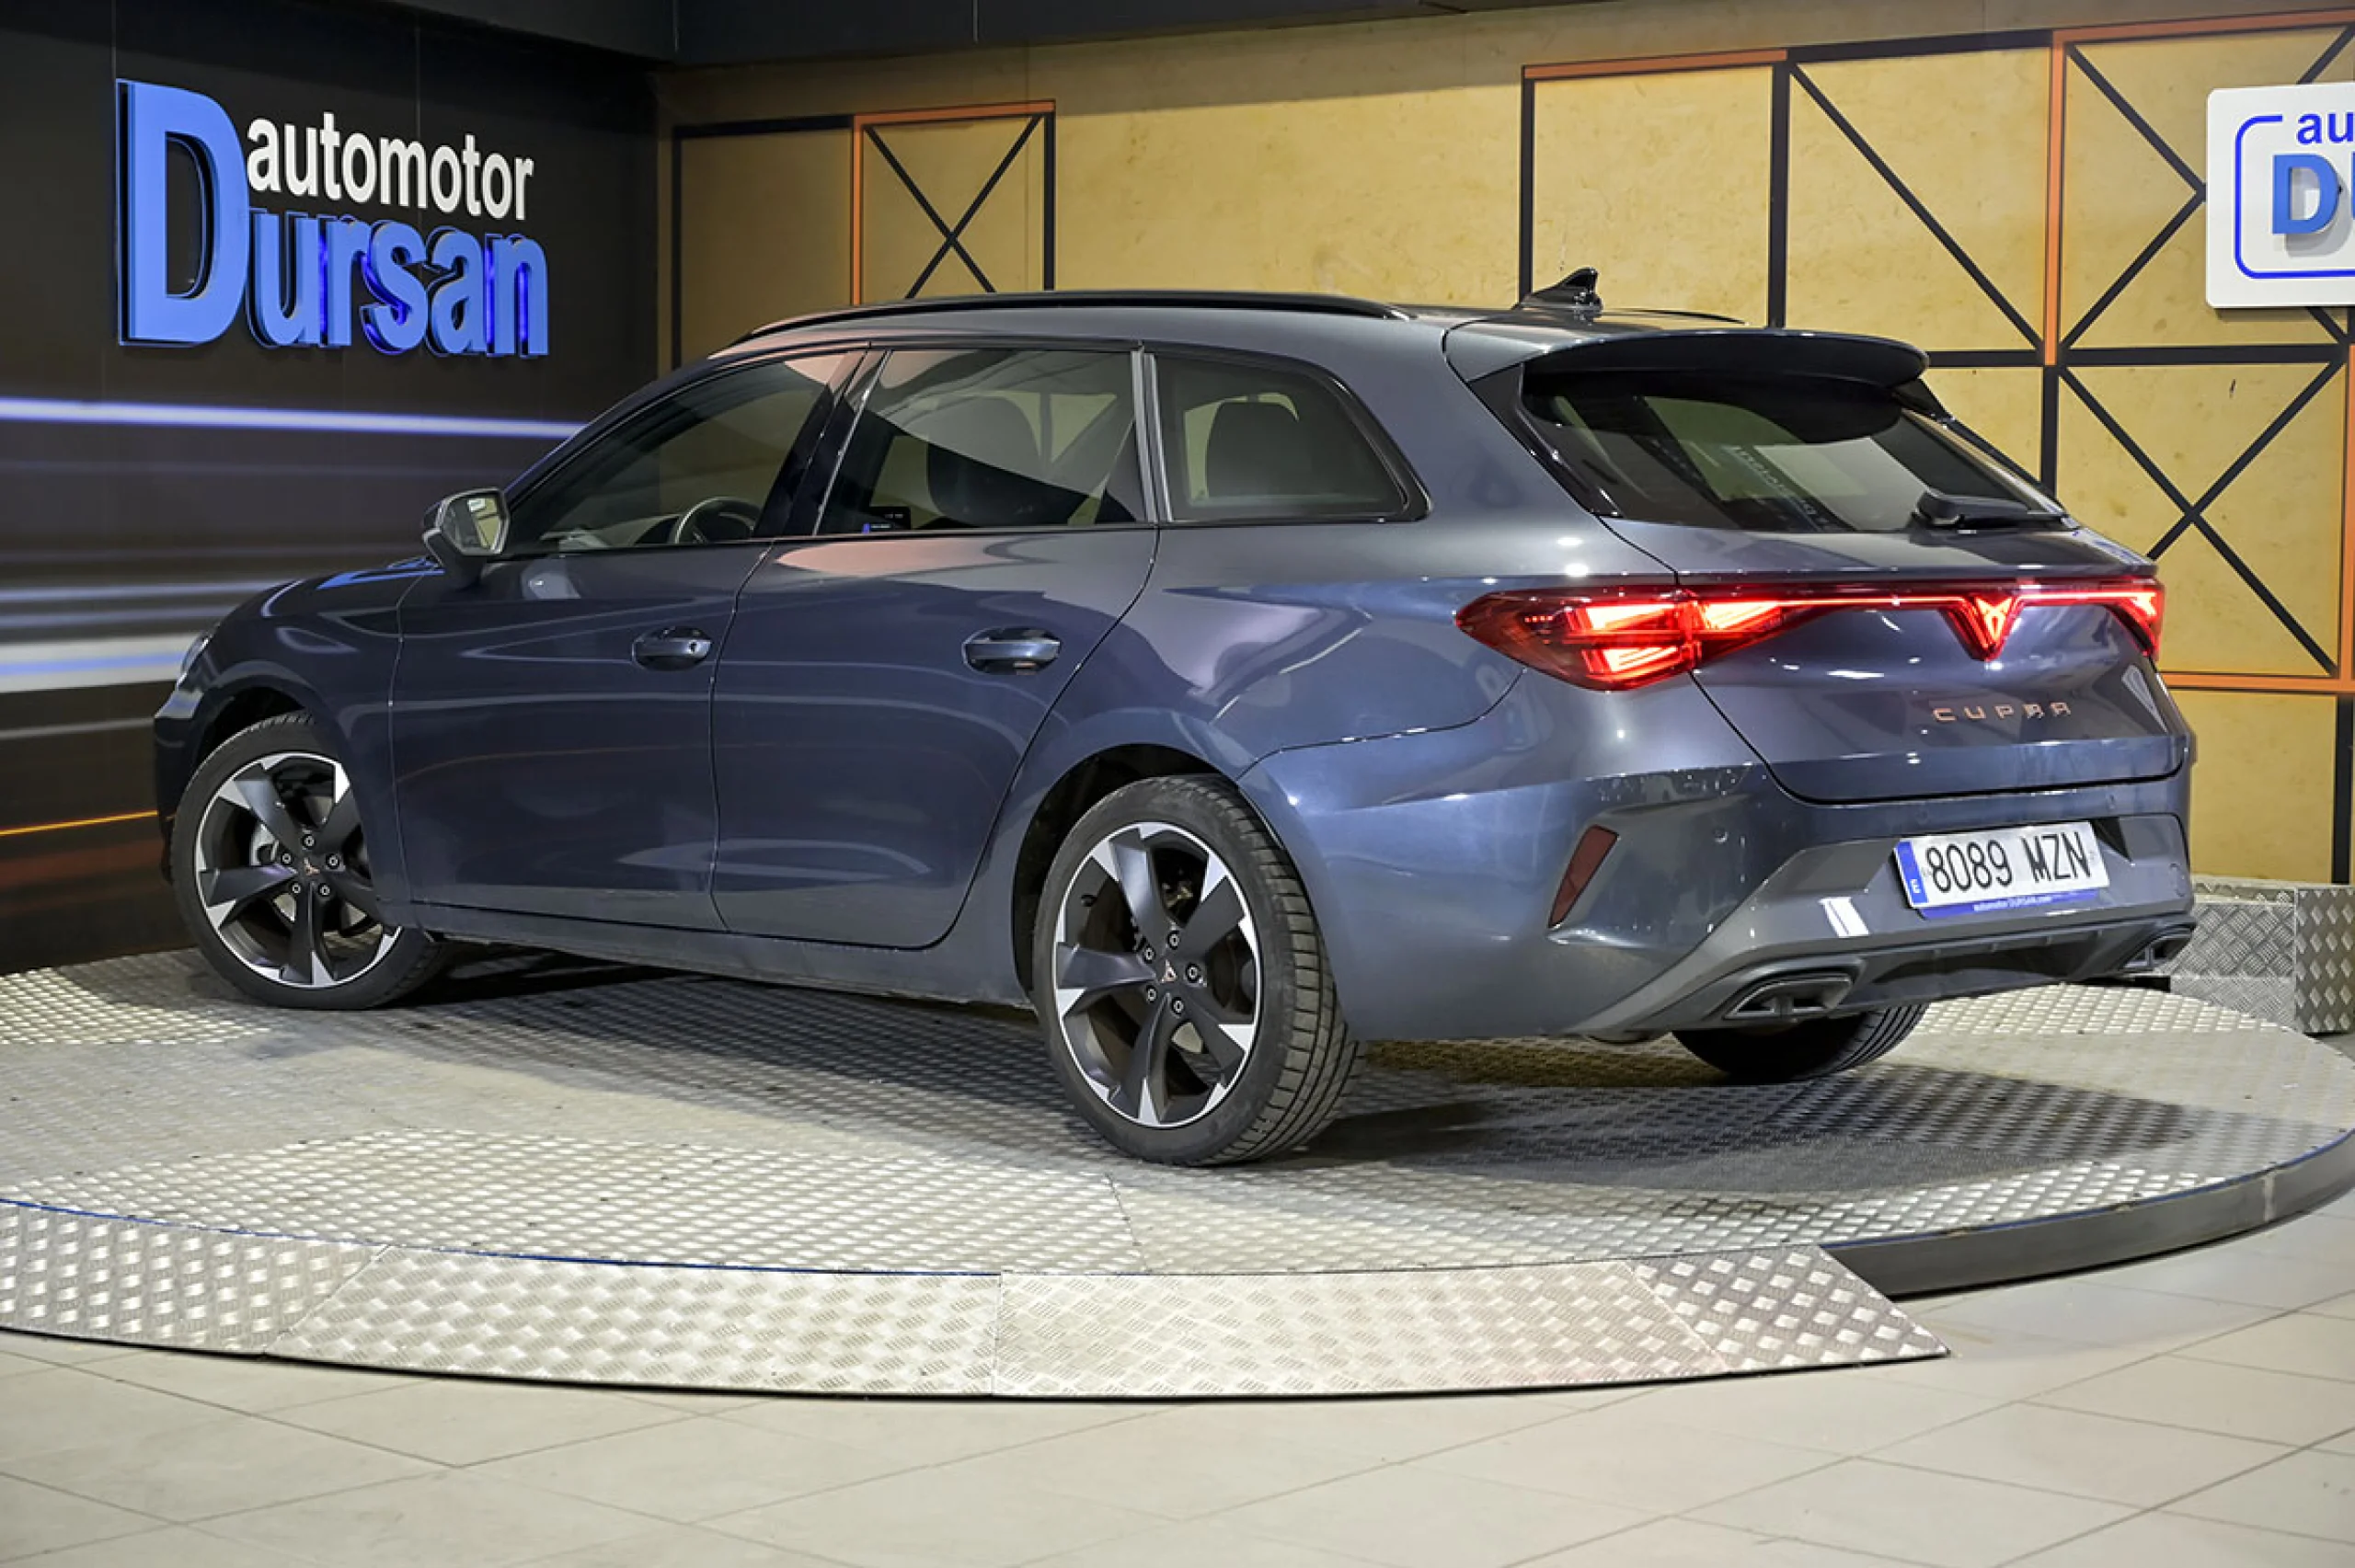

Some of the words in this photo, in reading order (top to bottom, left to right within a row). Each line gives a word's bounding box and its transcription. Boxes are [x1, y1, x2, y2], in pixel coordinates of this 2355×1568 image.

[2296, 112, 2355, 144] au
[247, 112, 534, 220] automotor
[2272, 152, 2355, 235] D
[116, 78, 549, 356] Dursan
[1933, 702, 2071, 722] CUPRA
[1910, 879, 1922, 894] E
[1926, 840, 2014, 893] 8089
[2021, 831, 2091, 883] MZN
